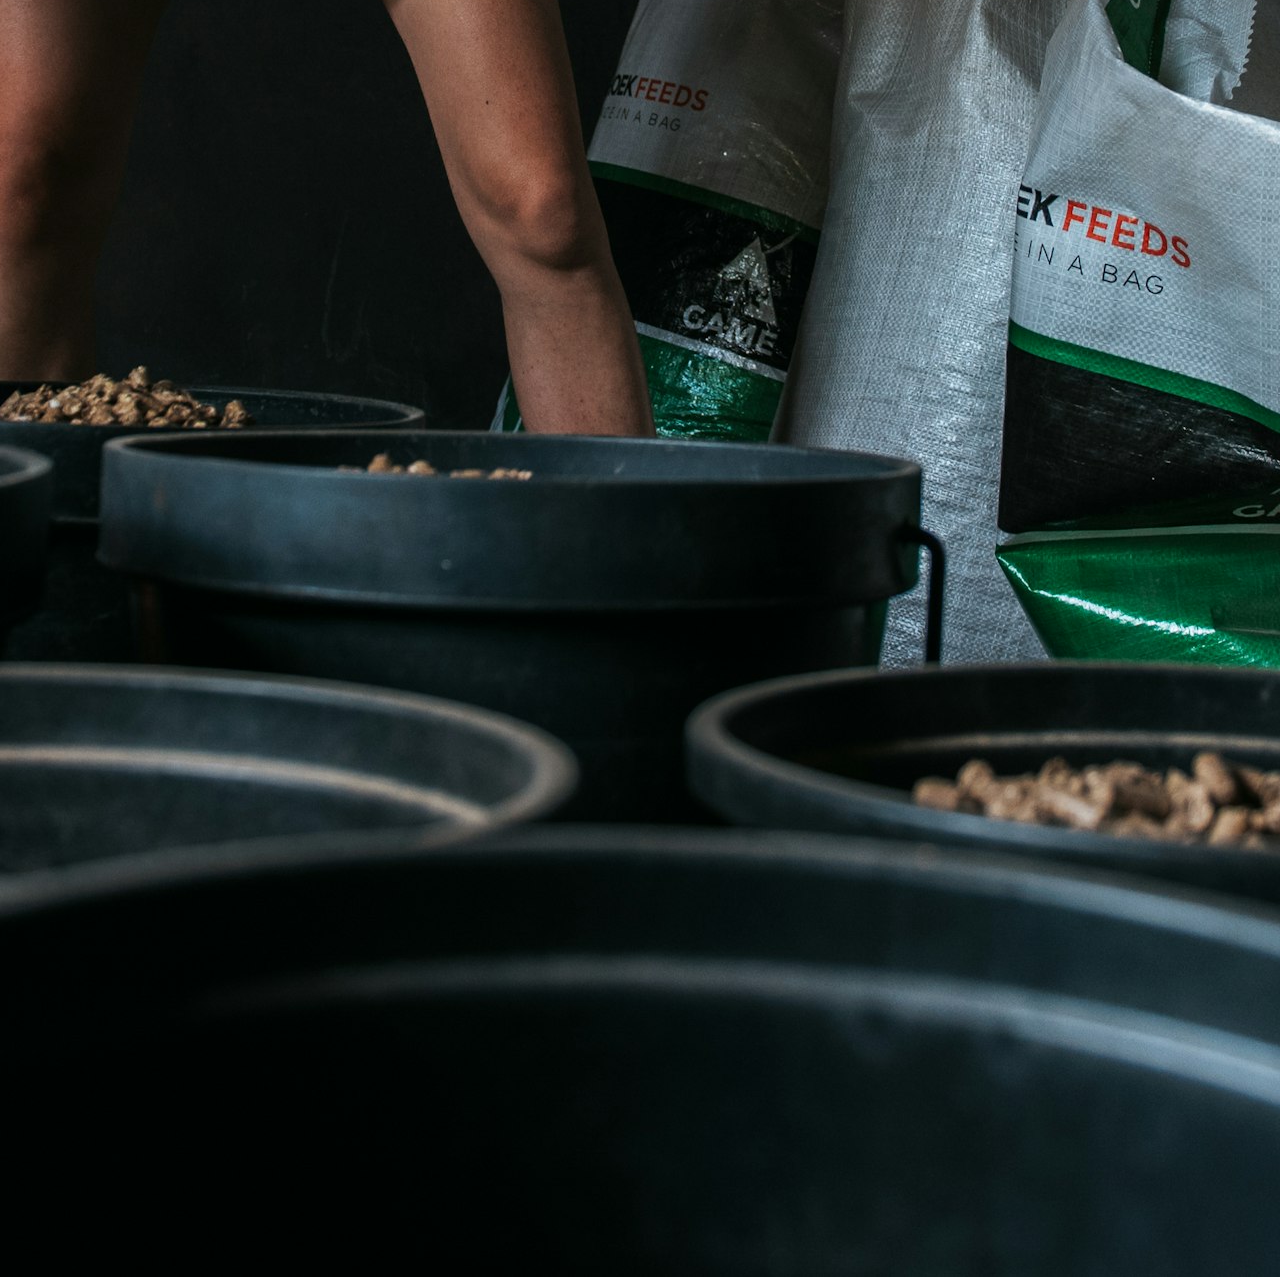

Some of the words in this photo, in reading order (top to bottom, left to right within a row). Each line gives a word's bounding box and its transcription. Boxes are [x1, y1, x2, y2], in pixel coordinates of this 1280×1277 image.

[635, 77, 708, 111] FEEDS
[648, 113, 681, 131] BAG
[1062, 199, 1192, 269] FEEDS
[1027, 239, 1055, 266] IN
[1067, 254, 1084, 276] A
[1101, 262, 1165, 295] BAG
